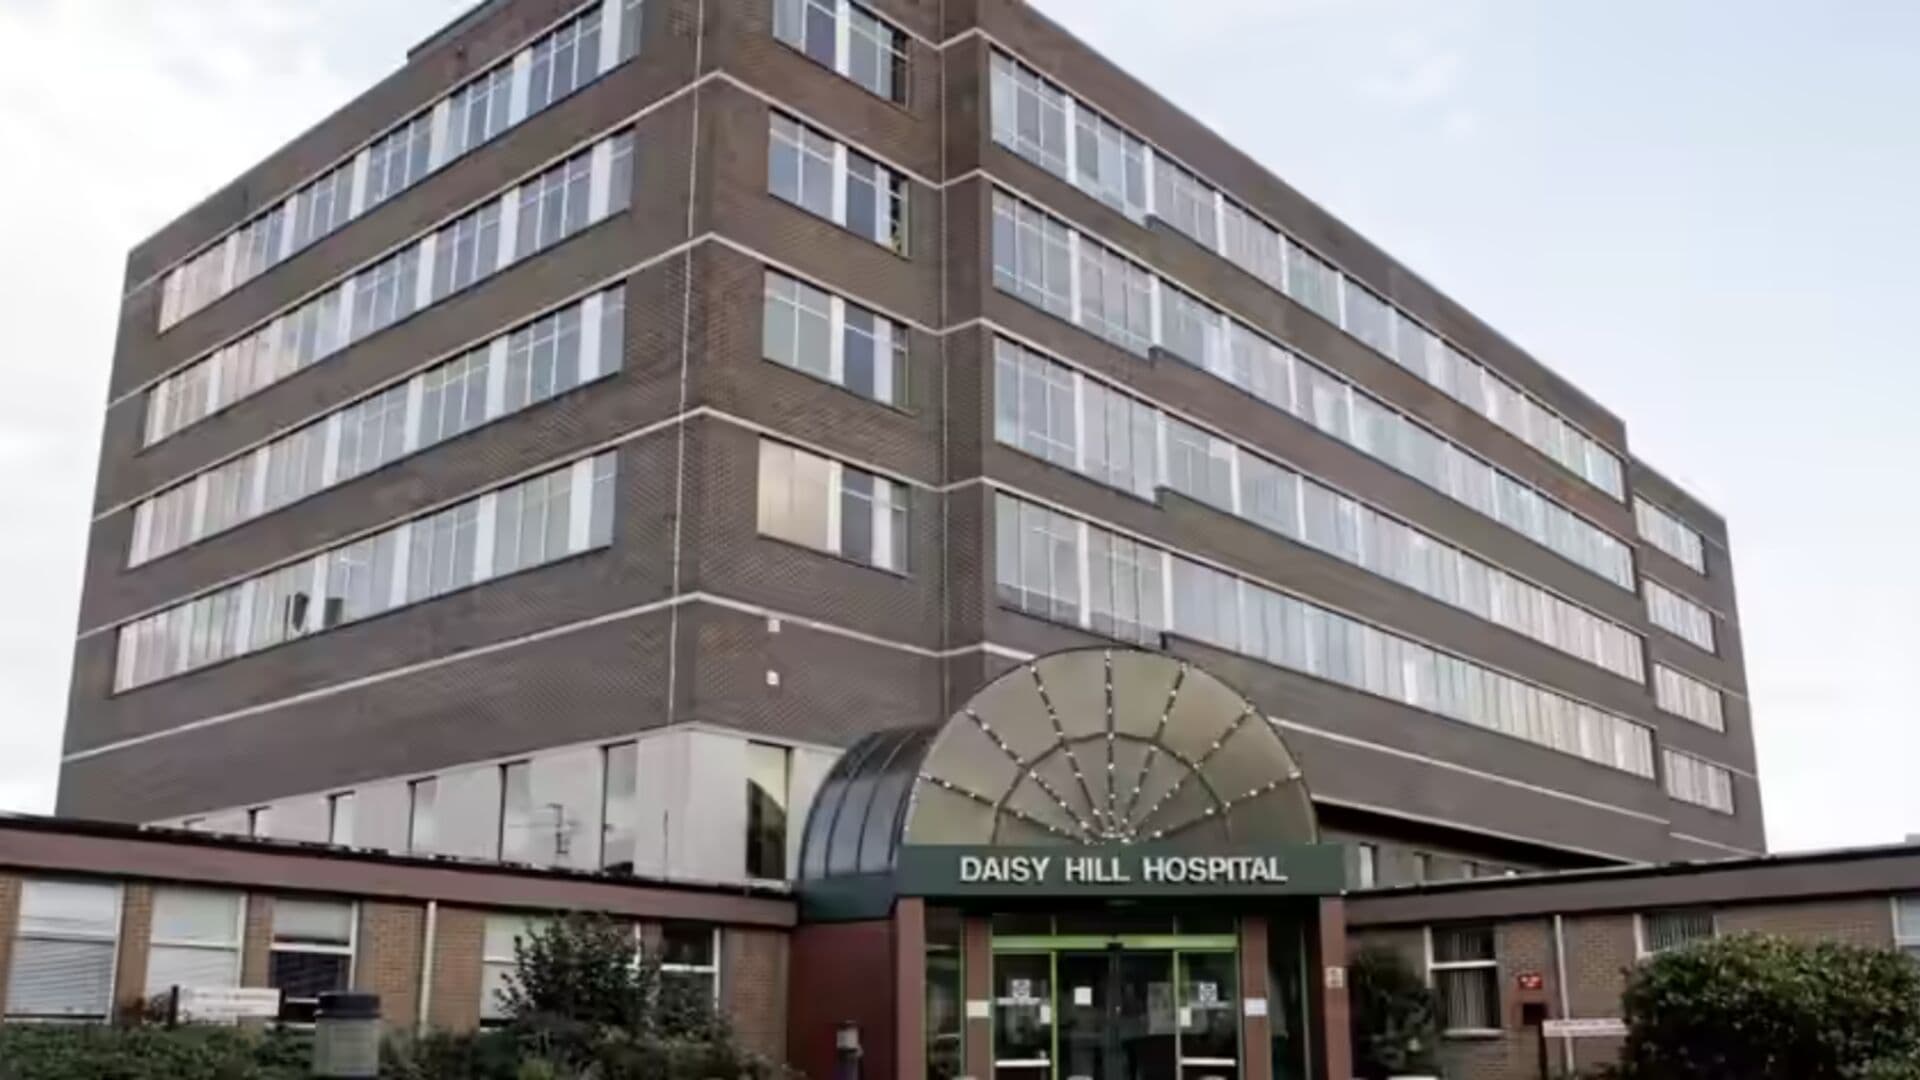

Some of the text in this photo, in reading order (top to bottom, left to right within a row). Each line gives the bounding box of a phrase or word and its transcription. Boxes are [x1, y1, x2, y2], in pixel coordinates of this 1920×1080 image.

[960, 856, 1288, 882] DAISY HILL HOSPITAL
